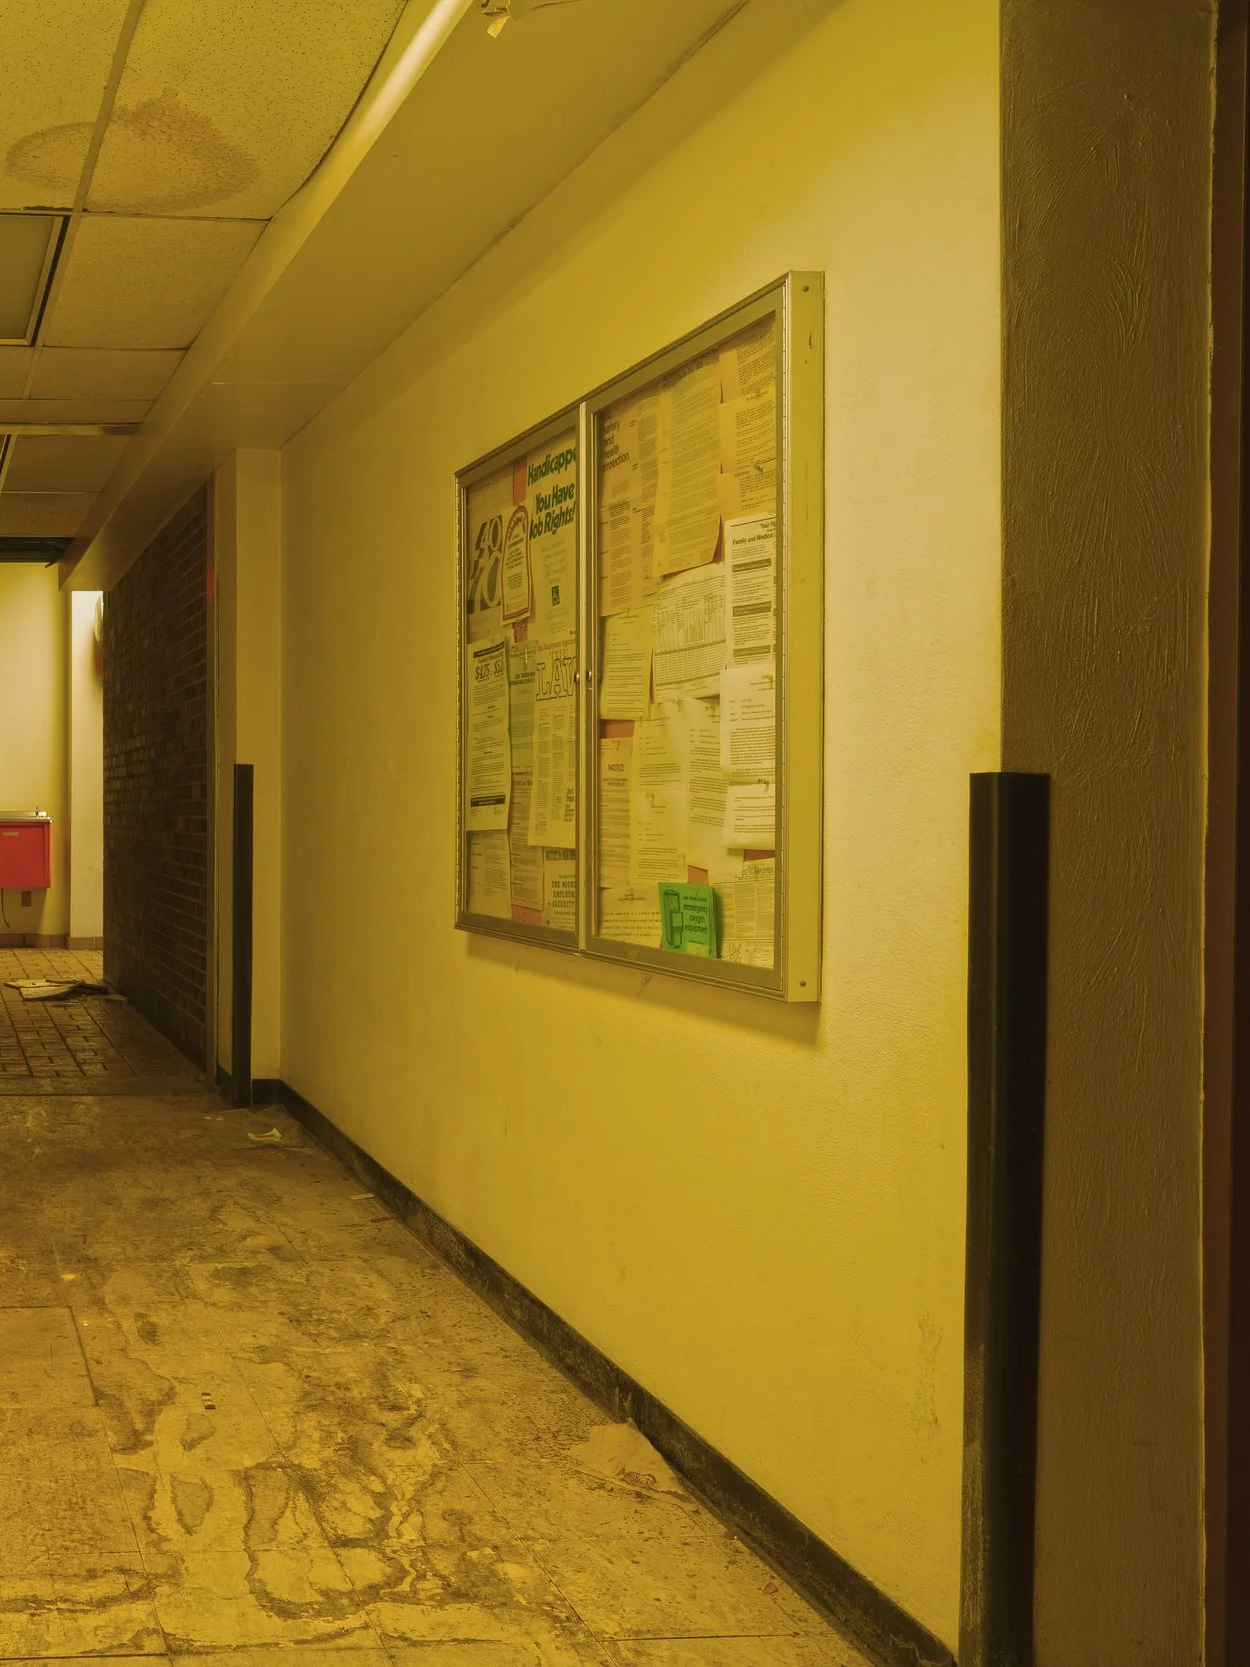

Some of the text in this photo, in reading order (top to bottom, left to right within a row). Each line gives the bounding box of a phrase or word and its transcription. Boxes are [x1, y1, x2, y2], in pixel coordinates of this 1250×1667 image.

[602, 451, 630, 472] protection
[536, 483, 575, 515] You Have
[529, 515, 543, 541] Job
[544, 500, 576, 536] Rights!
[607, 763, 626, 772] NOTICE
[683, 904, 708, 915] emergency
[688, 915, 705, 924] oxygen
[684, 924, 708, 934] equipment
